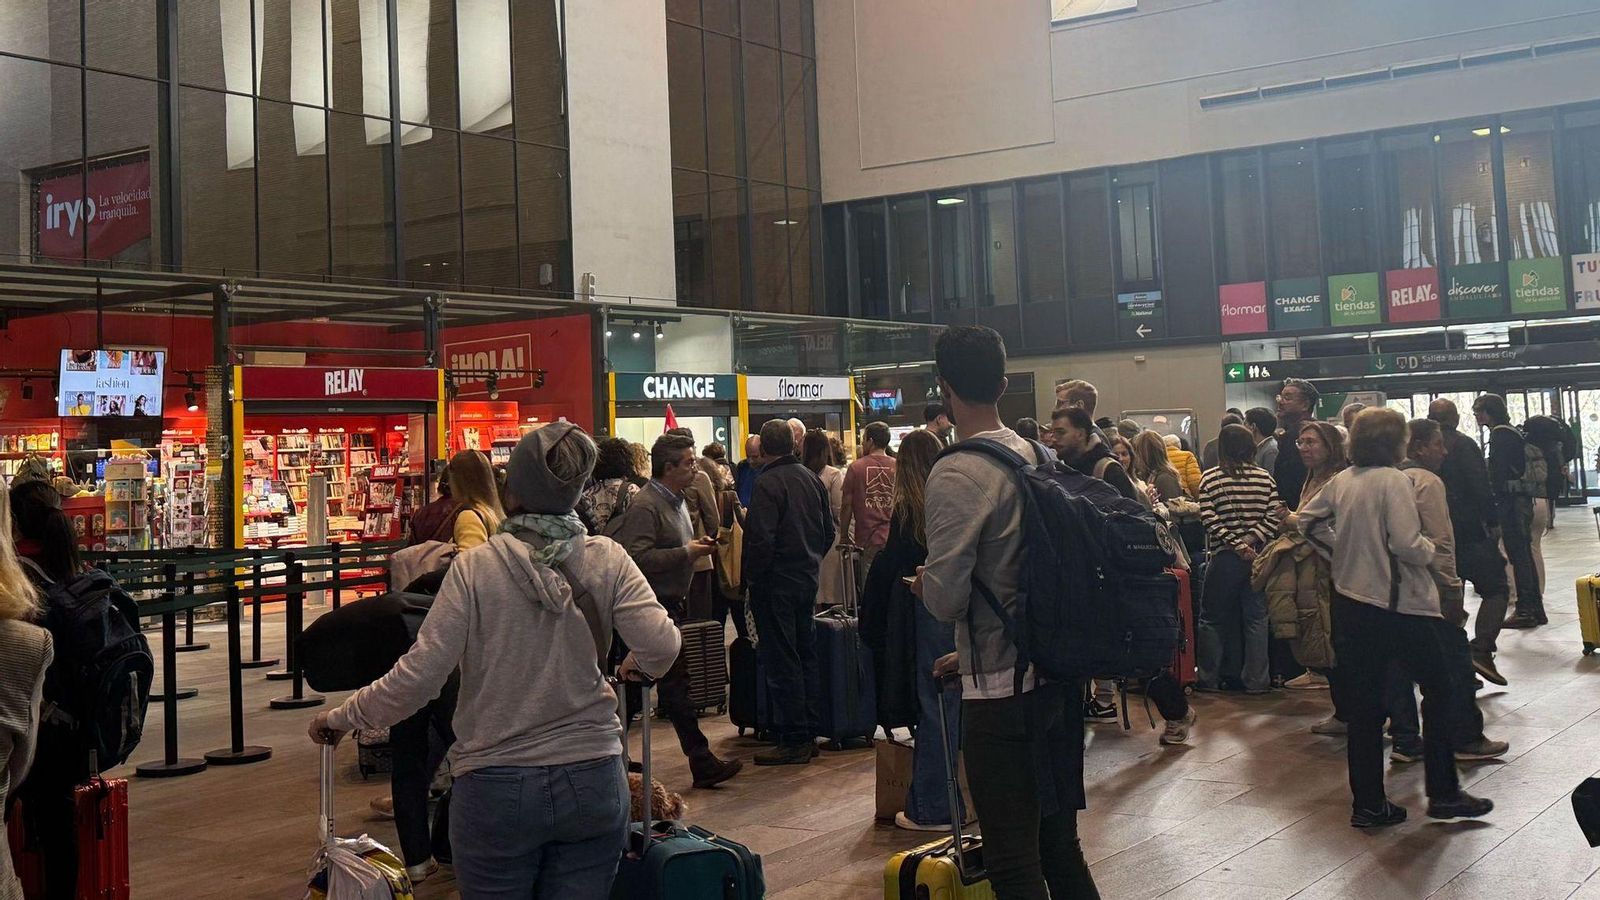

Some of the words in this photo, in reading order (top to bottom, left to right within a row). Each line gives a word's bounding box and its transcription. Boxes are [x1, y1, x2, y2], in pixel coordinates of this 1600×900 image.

[99, 194, 110, 207] La
[112, 187, 151, 204] velocidad
[46, 193, 96, 237] iryo
[99, 204, 139, 221] tranquila.
[1576, 259, 1600, 274] TU
[1391, 284, 1432, 307] RELAY
[1448, 276, 1499, 297] discover
[1515, 285, 1560, 298] tiendas
[1275, 294, 1321, 306] CHANGE
[1334, 300, 1376, 312] tiendas
[1221, 304, 1267, 317] flormar
[451, 346, 524, 386] ¡HOLA!
[1408, 356, 1418, 369] D
[1421, 354, 1446, 363] Salida
[1472, 351, 1500, 360] Kansas
[1501, 350, 1517, 360] City
[95, 377, 130, 389] fashion
[324, 369, 364, 396] RELAY
[642, 376, 716, 399] CHANGE
[778, 378, 824, 398] flormar
